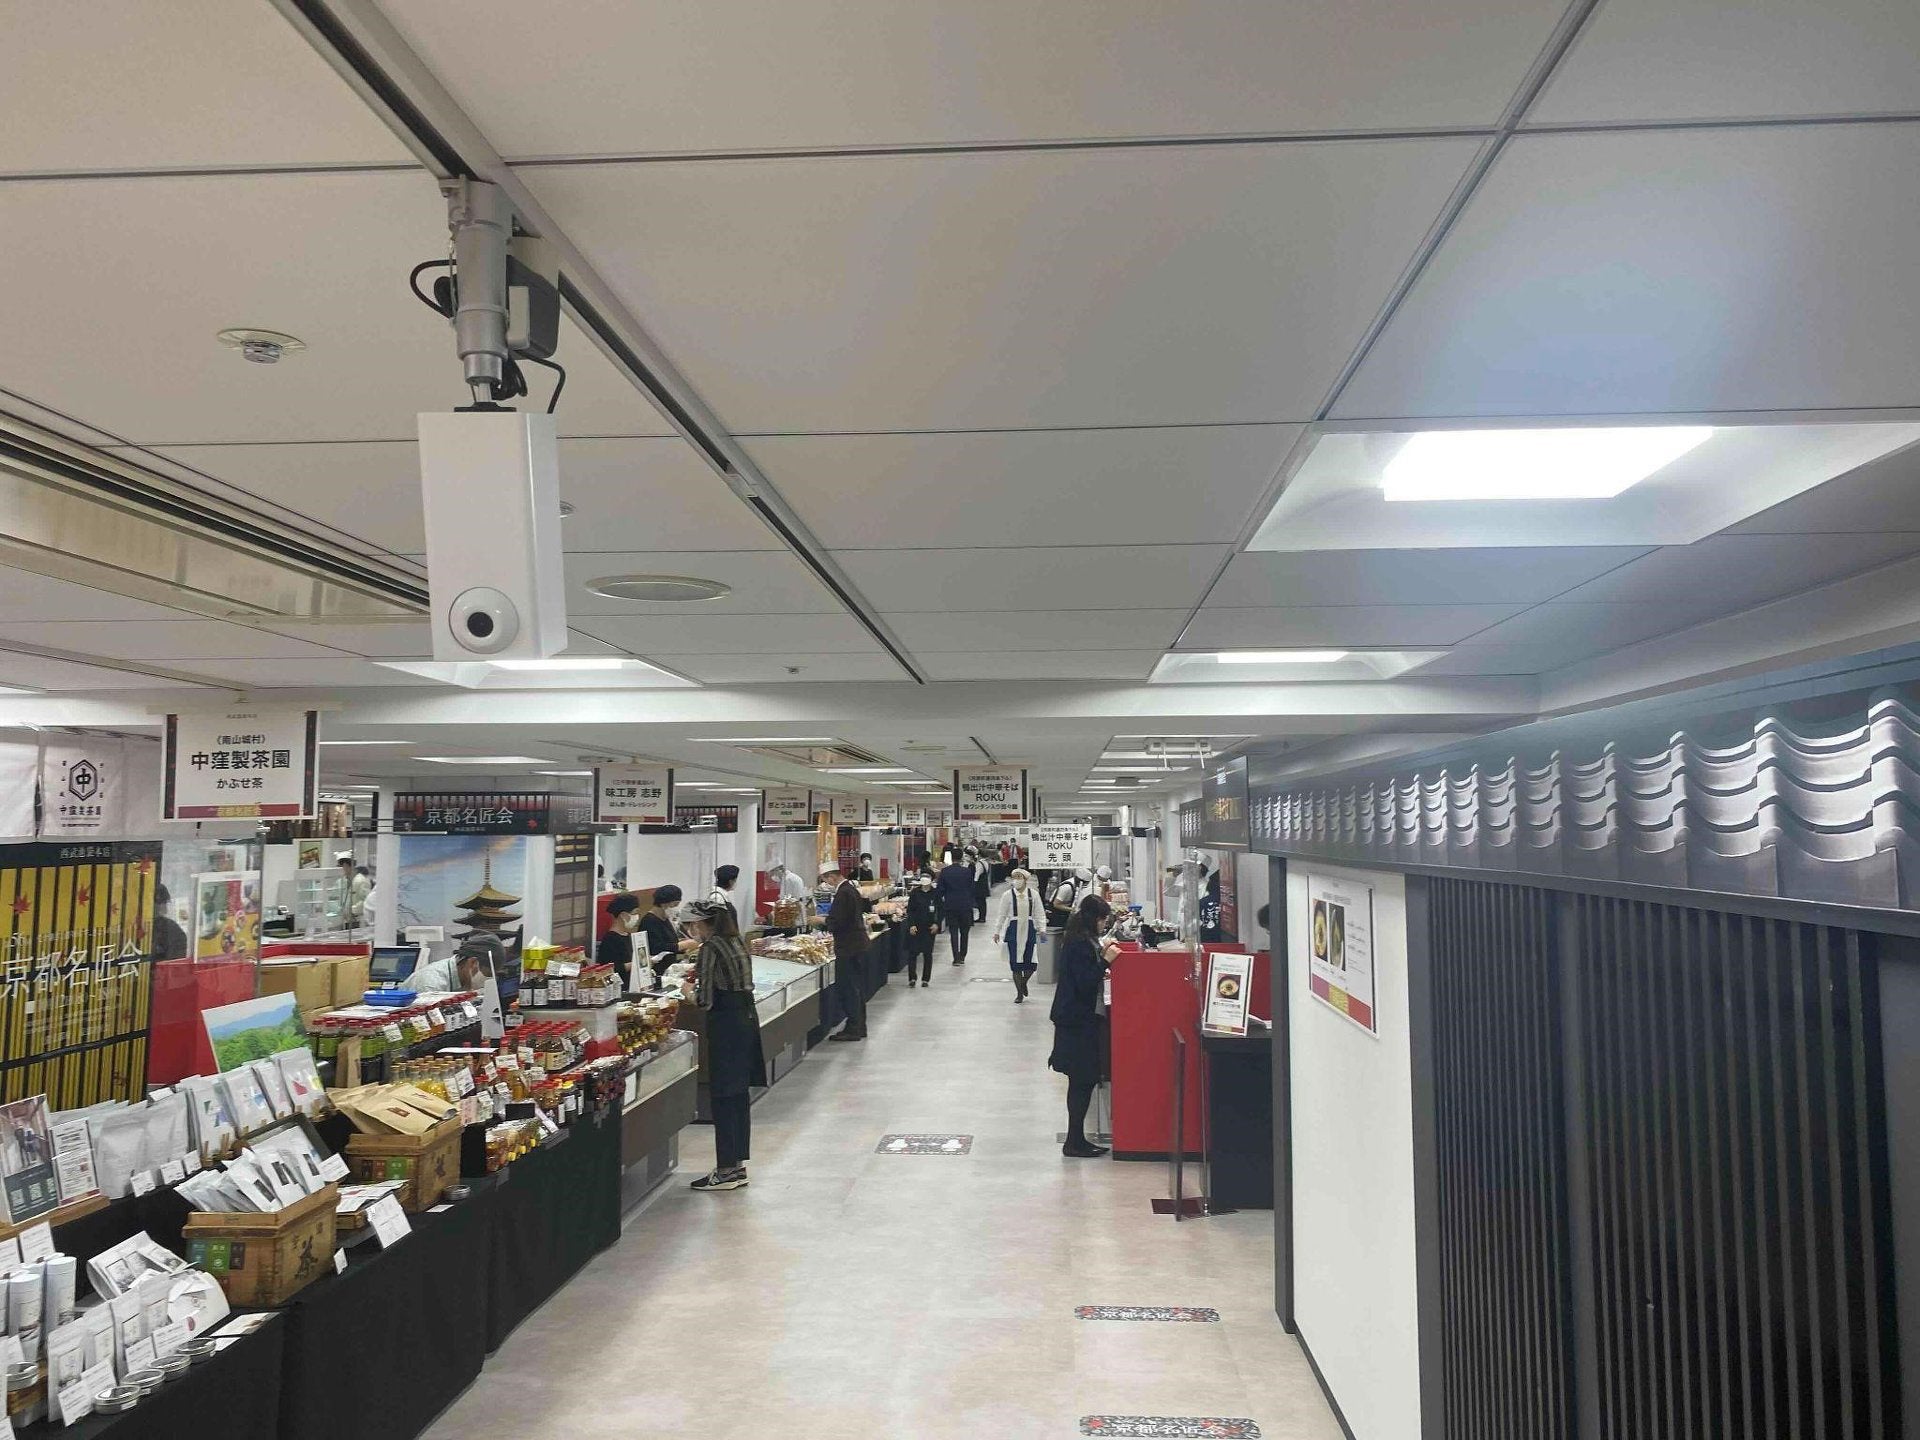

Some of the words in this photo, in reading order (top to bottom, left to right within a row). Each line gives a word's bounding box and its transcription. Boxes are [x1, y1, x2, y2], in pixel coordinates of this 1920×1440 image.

[191, 750, 290, 770] 中窪製茶園
[76, 767, 92, 794] 中
[216, 777, 263, 789] かぶせ茶
[605, 787, 636, 798] 味工房
[641, 788, 662, 798] 志野
[975, 793, 1005, 801] ROKU
[425, 806, 514, 825] 京都名匠会
[1031, 832, 1088, 841] 鴨出汁中華そば
[1046, 842, 1073, 850] ROKU
[0, 938, 143, 1000] 京都名匠会
